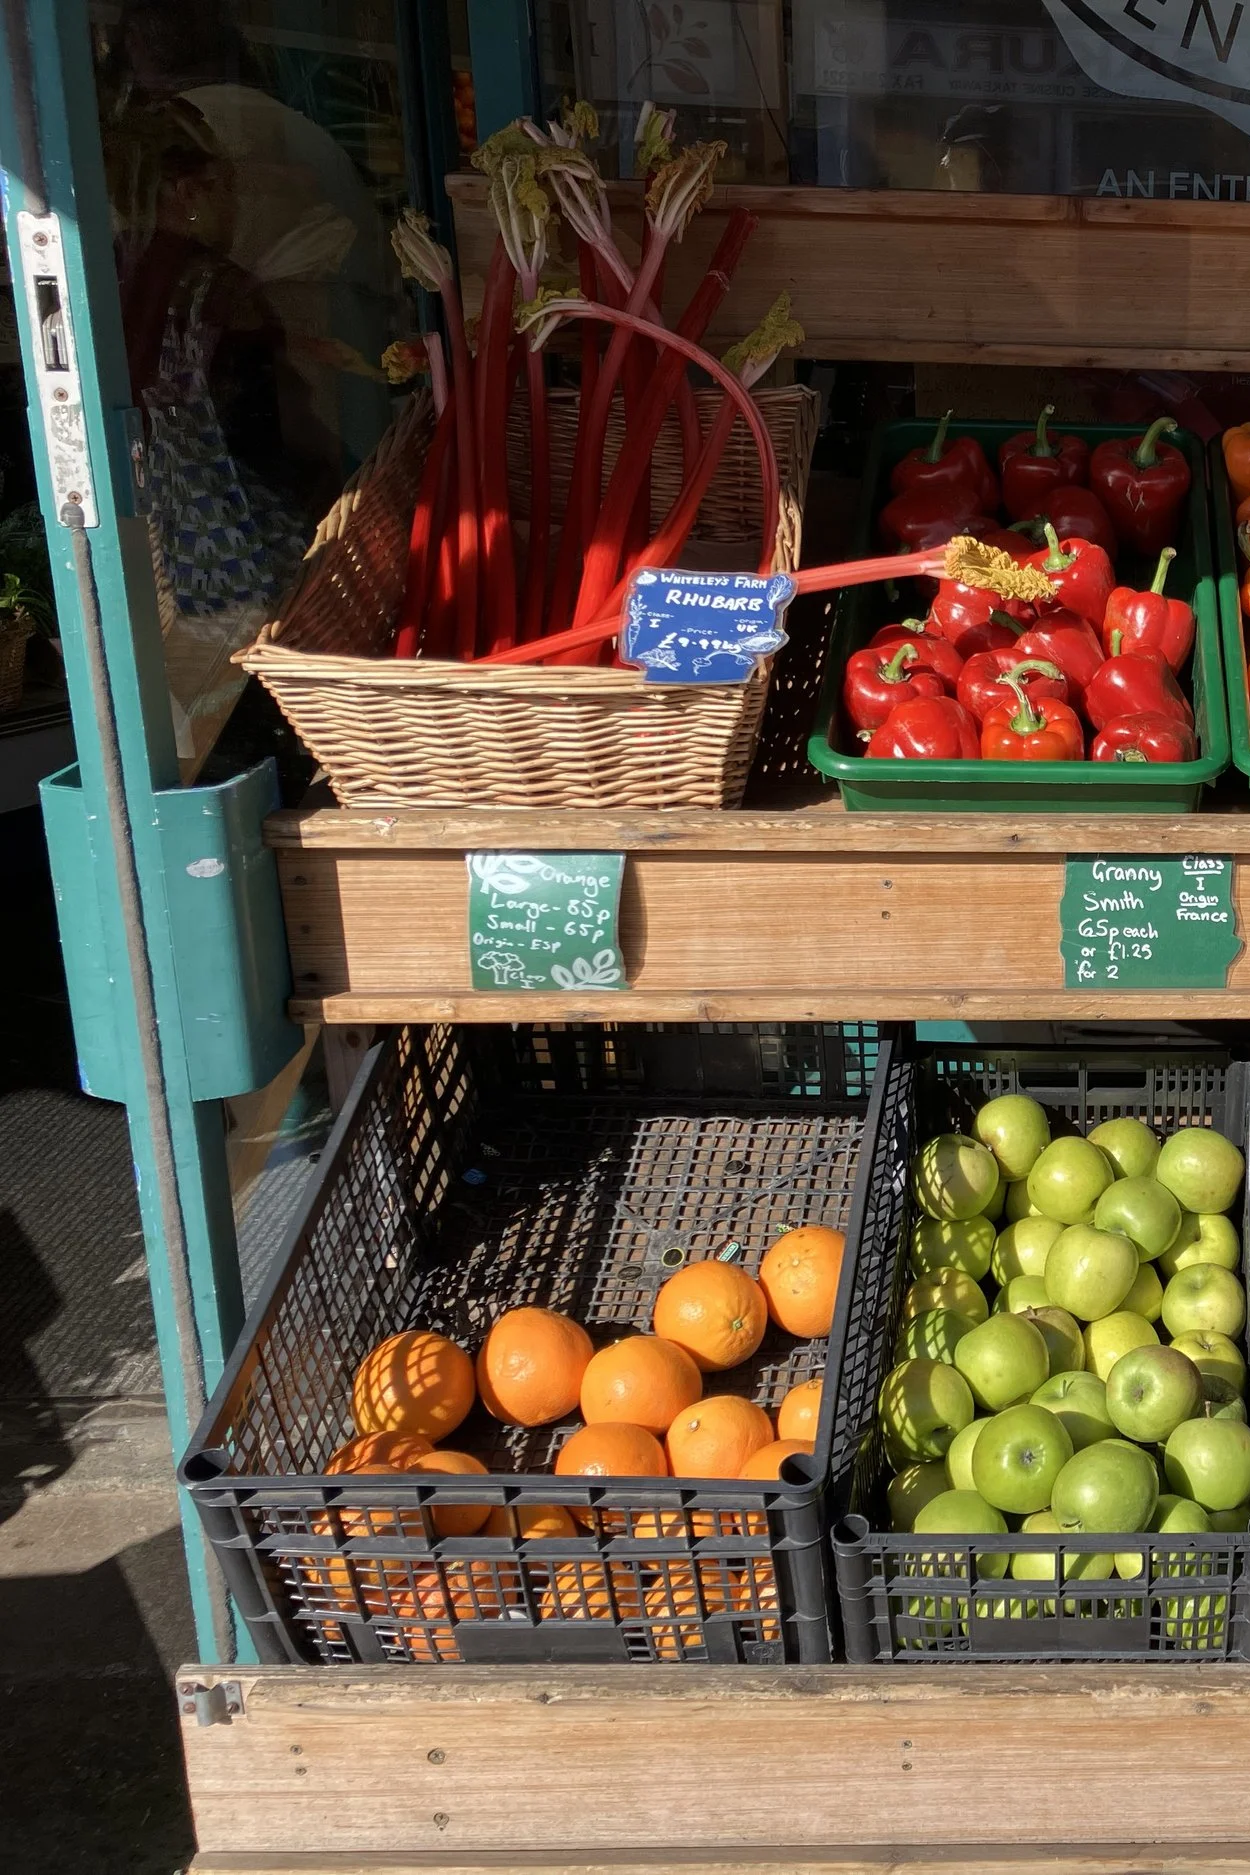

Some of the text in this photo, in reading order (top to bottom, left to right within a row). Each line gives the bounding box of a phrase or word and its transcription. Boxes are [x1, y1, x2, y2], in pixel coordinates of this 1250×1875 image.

[1095, 168, 1155, 198] AN
[665, 589, 765, 612] RHUBARB
[736, 624, 760, 633] UK
[1182, 855, 1225, 870] Class
[540, 864, 611, 898] Orange
[1092, 860, 1163, 891] Granny
[1083, 890, 1145, 912] Smith
[1179, 891, 1219, 907] Origin
[1176, 908, 1229, 923] France
[486, 914, 537, 933] Small
[564, 921, 605, 944] 65p
[1078, 918, 1159, 945] 65p each
[1081, 942, 1153, 961] or £1.25
[1076, 960, 1119, 983] for 2
